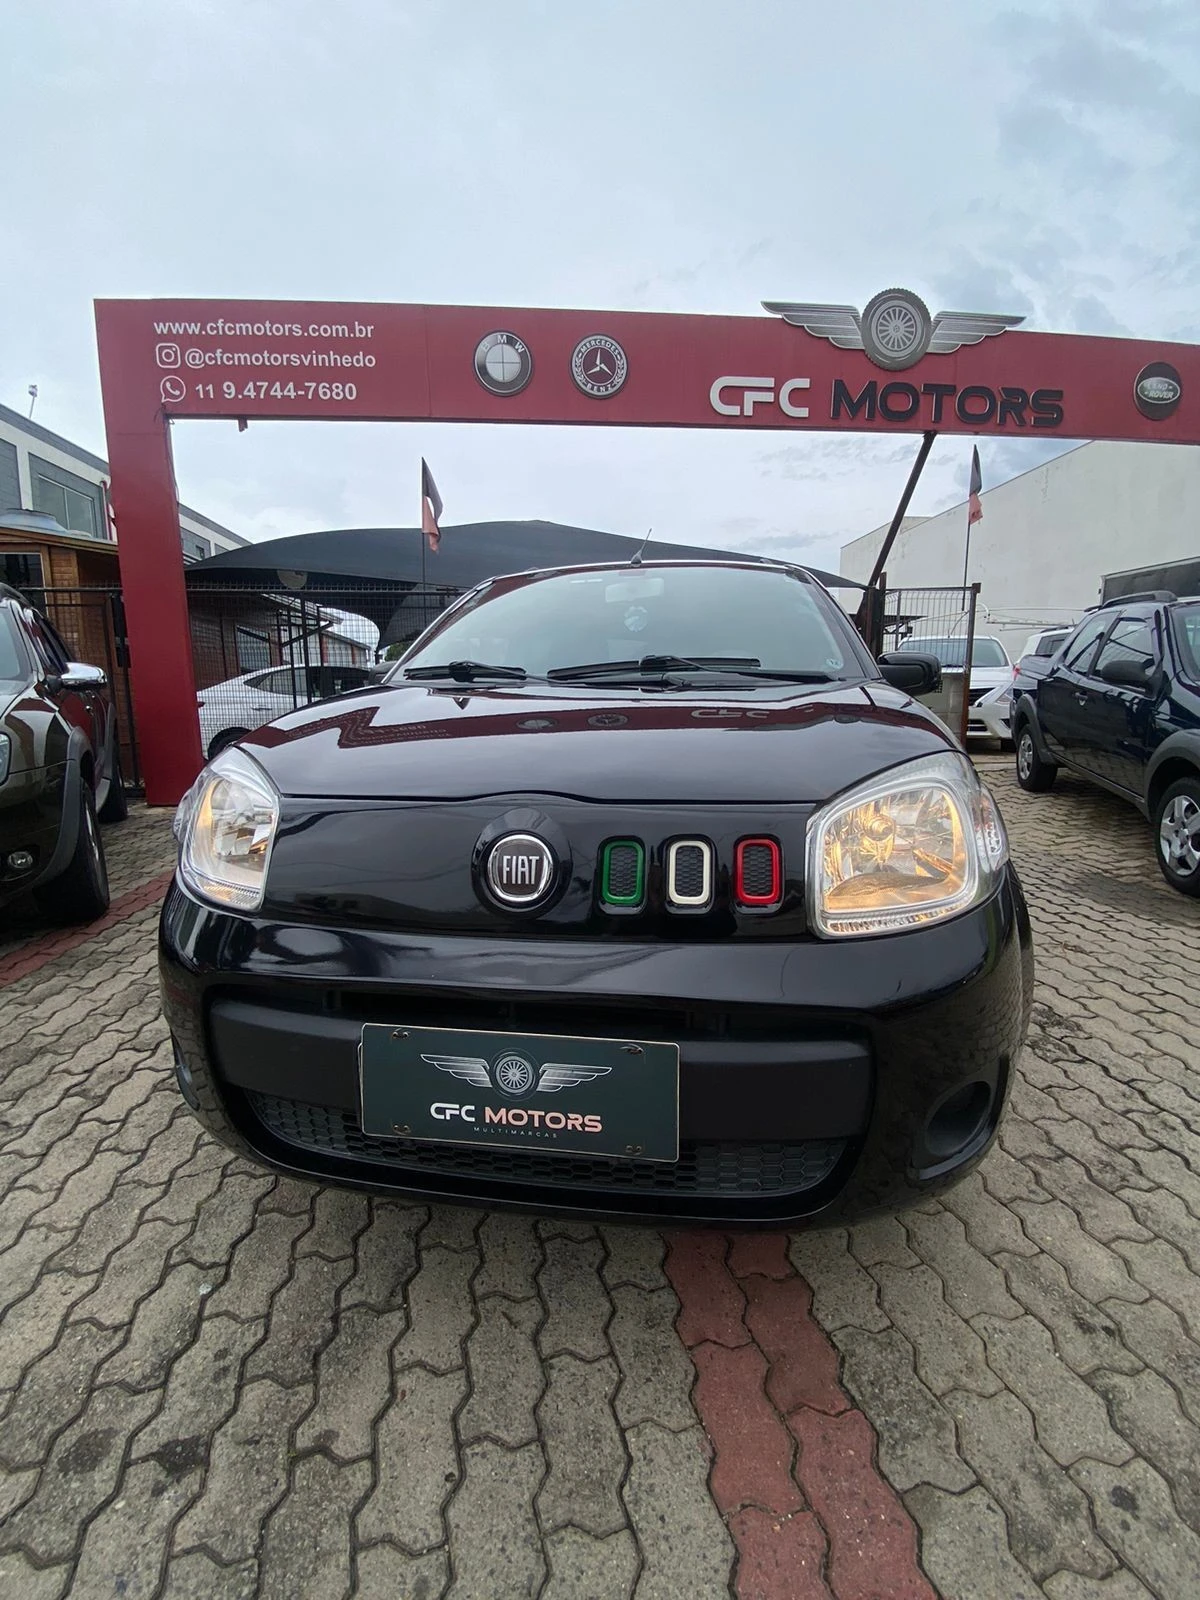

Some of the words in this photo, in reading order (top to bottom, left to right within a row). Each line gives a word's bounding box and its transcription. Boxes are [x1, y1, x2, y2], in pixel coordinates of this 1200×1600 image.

[153, 318, 374, 338] www.cfcmotors.com.br
[481, 334, 525, 353] BMW
[580, 339, 620, 355] MERCEDES
[185, 348, 376, 369] @cfcmotorsvinhedo
[195, 383, 214, 399] 11
[222, 381, 358, 401] 9.4744-7680
[709, 375, 811, 418] CFC
[831, 378, 1064, 428] MOTORS
[502, 855, 540, 885] FIAT
[430, 1102, 476, 1122] CFC
[484, 1106, 603, 1133] MOTORS
[473, 1126, 558, 1139] MULTIMARCAS
